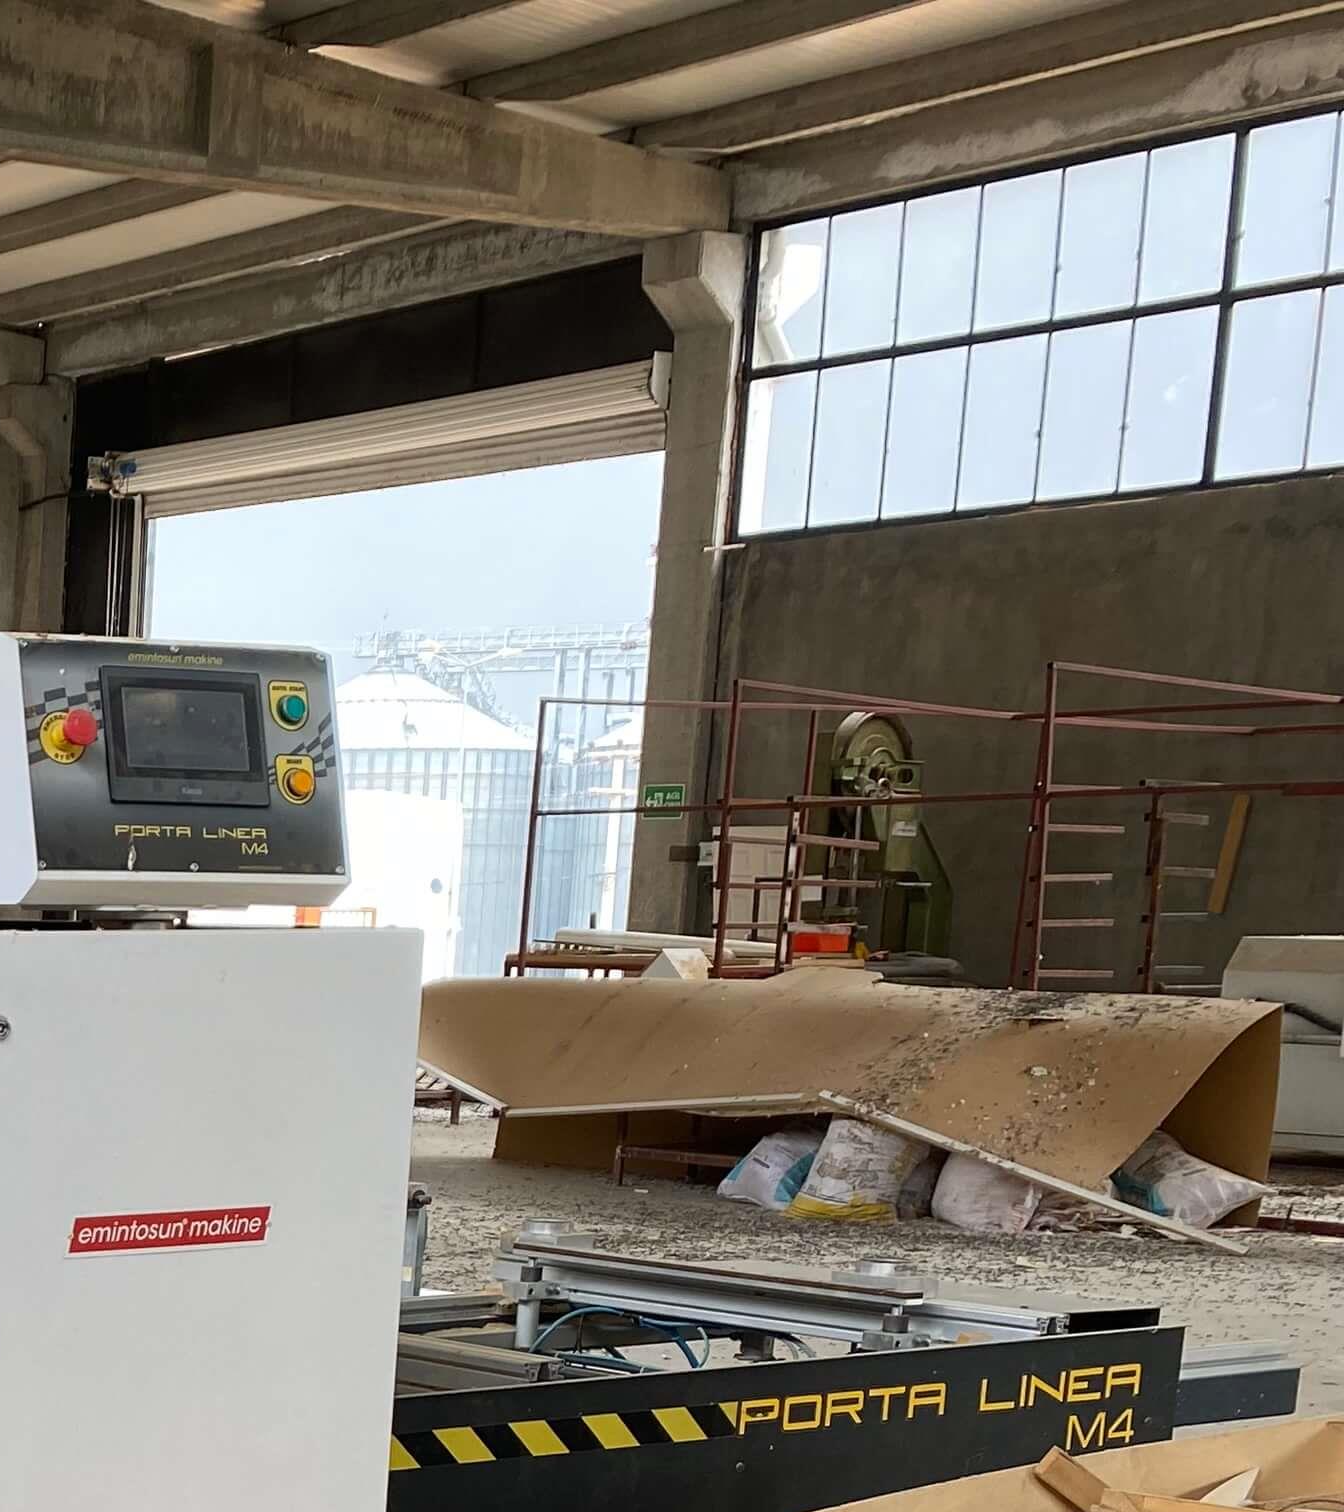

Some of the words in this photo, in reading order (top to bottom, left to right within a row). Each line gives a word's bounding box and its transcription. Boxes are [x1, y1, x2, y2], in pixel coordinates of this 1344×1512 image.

[183, 655, 224, 666] makine
[114, 824, 191, 838] PORTA
[203, 826, 267, 839] LINEA
[241, 842, 269, 855] M4
[78, 1219, 184, 1244] emintosun
[188, 1213, 262, 1237] makine
[737, 1381, 947, 1436] PORTA
[979, 1362, 1142, 1413] LINEA
[1065, 1408, 1135, 1452] M4
